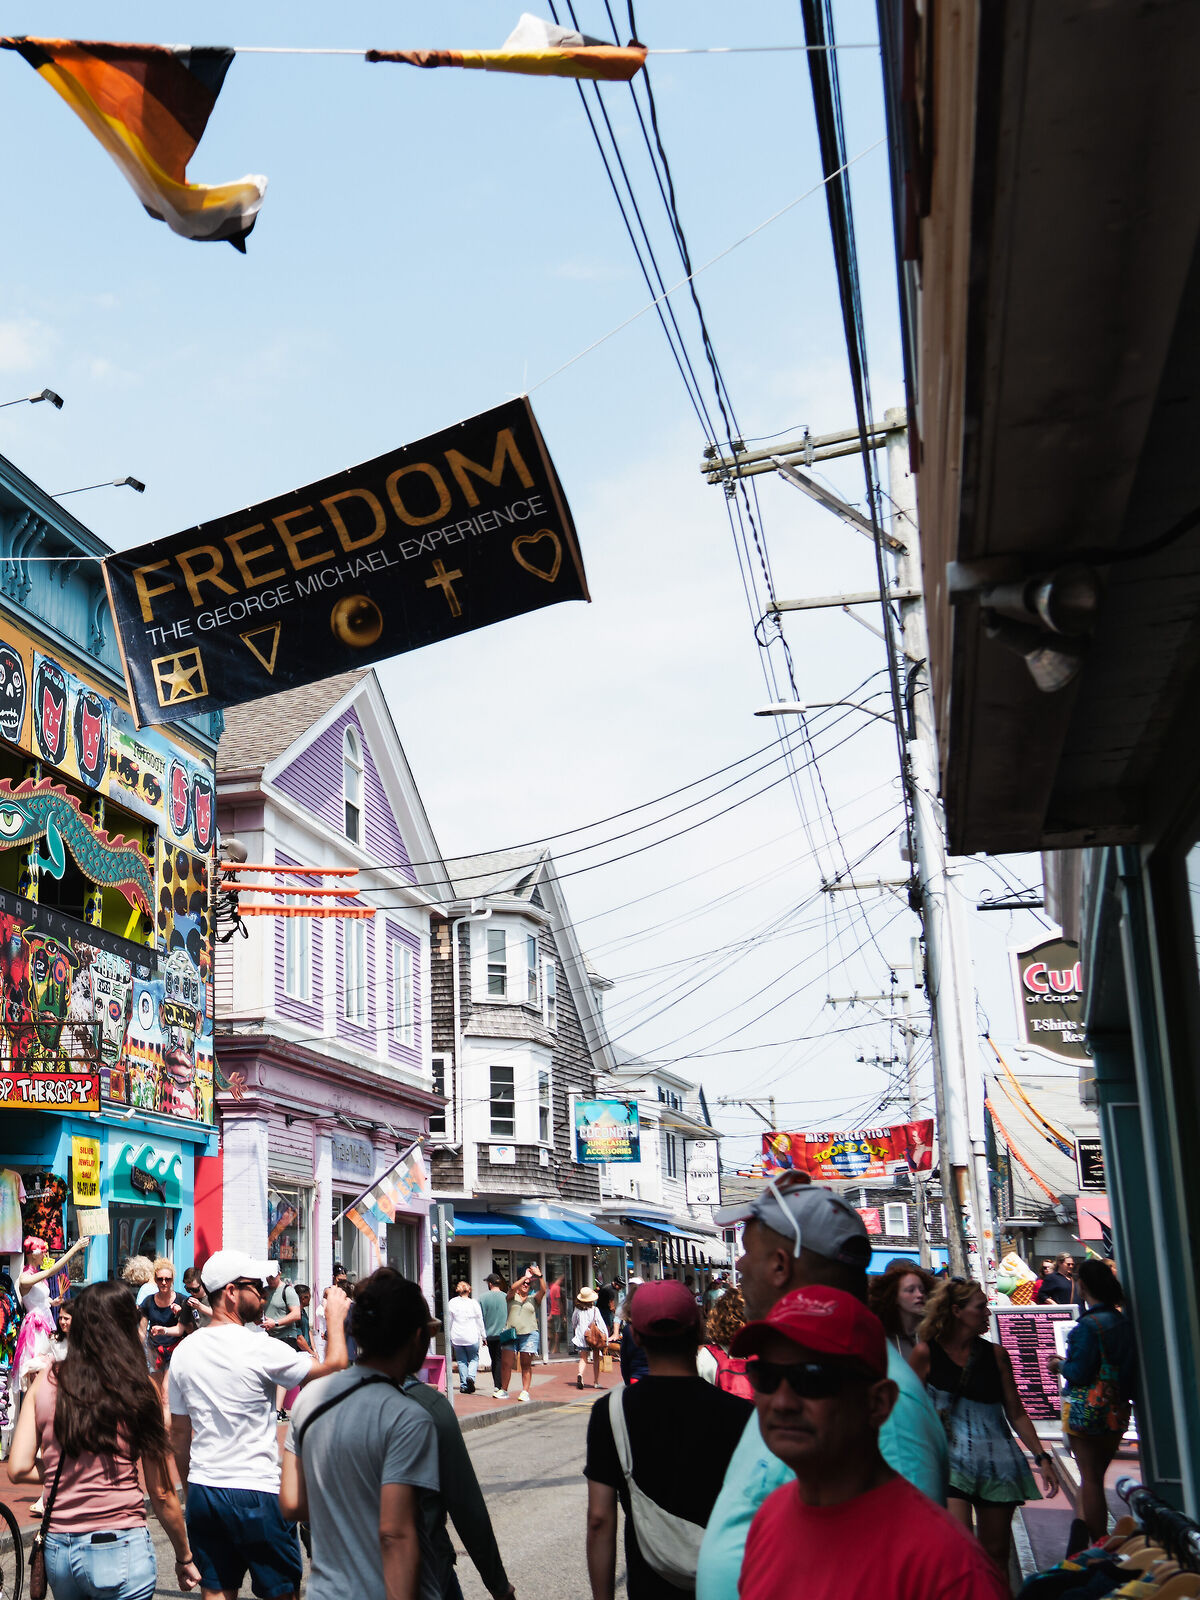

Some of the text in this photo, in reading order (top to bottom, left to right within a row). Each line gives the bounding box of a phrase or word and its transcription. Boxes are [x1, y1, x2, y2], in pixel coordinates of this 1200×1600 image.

[132, 428, 535, 623] FREEDOM
[146, 495, 548, 647] THE GEORGE MICHAEL EXPERIENCE
[1026, 994, 1079, 1004] of Cape
[1030, 1018, 1078, 1031] T-Shirts
[1061, 1030, 1086, 1043] Res
[17, 1079, 92, 1104] THERAPY
[579, 1124, 638, 1139] COCONUTS
[587, 1139, 631, 1147] SUNGLASSES
[804, 1133, 829, 1144] MISS
[586, 1147, 632, 1155] ACCESSORIES
[813, 1141, 889, 1162] TOONED OUT
